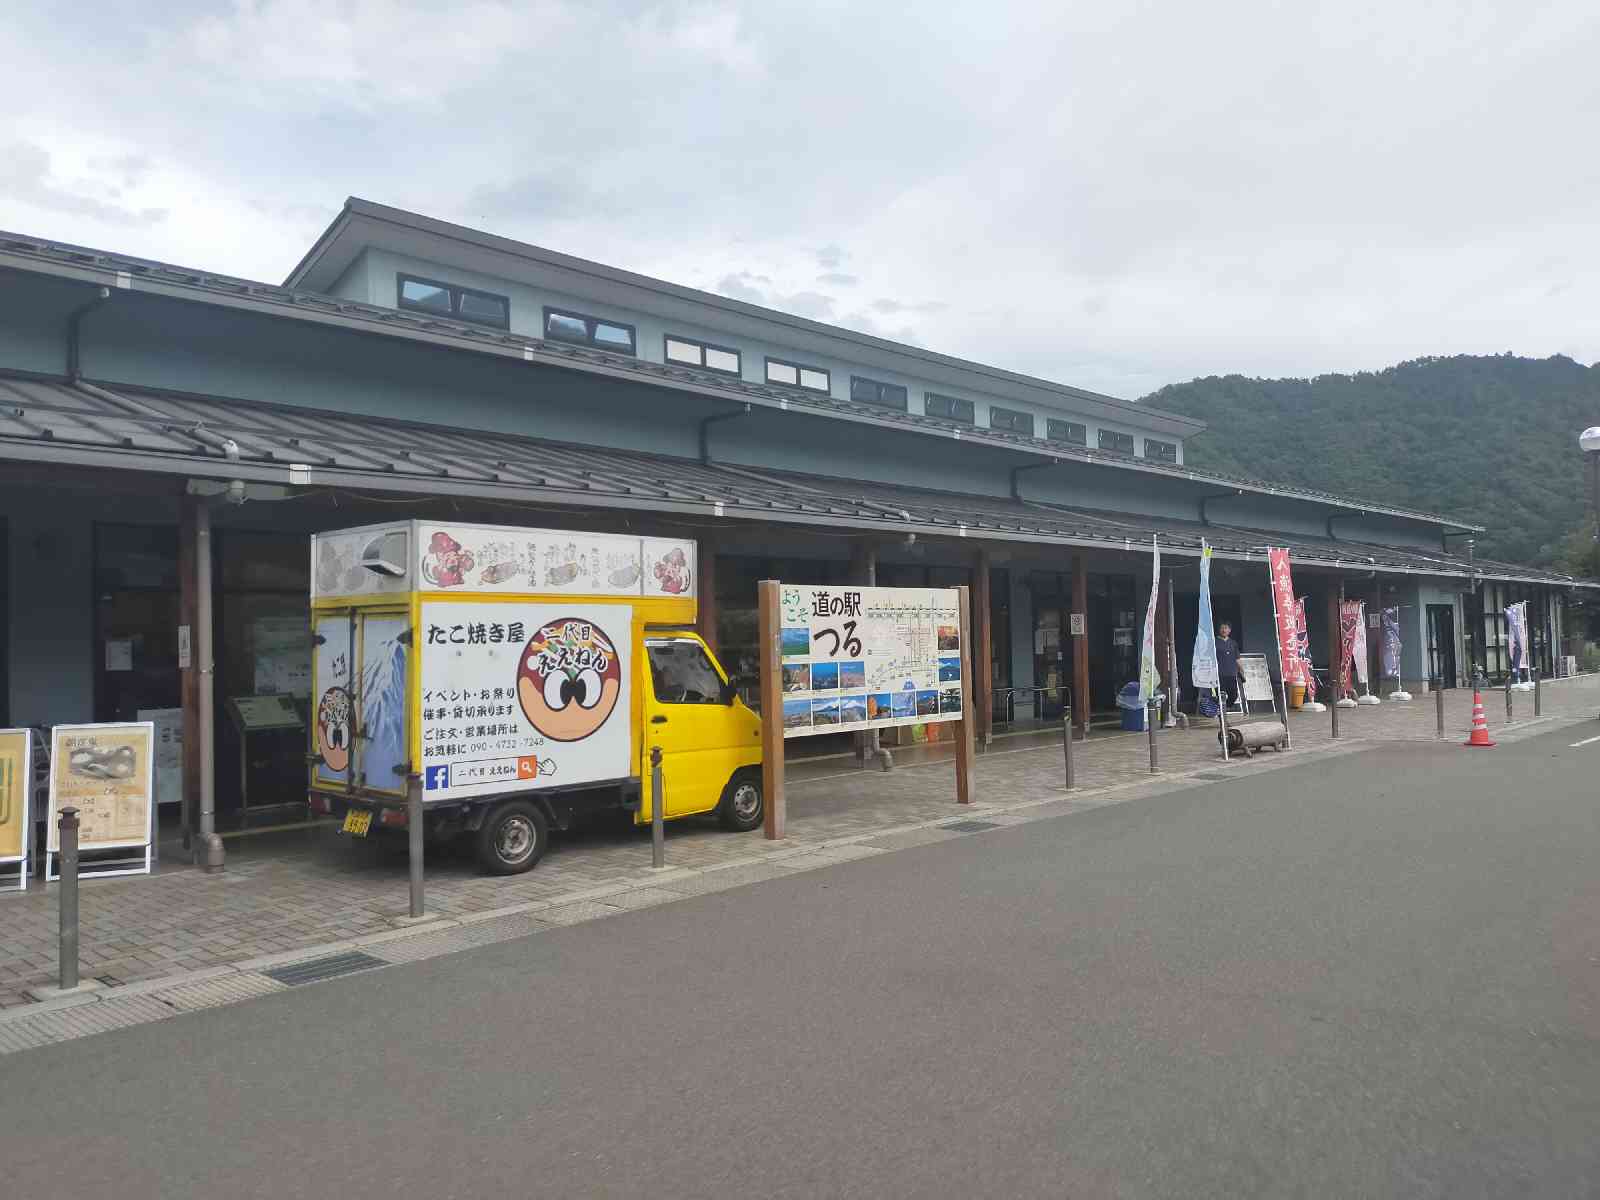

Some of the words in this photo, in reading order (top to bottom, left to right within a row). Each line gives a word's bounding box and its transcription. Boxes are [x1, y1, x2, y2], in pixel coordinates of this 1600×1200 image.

[811, 591, 862, 617] 道の駅
[428, 622, 525, 645] たこ焼き屋
[545, 622, 590, 641] 二代目
[813, 620, 862, 657] つる
[424, 744, 467, 757] お気軽に
